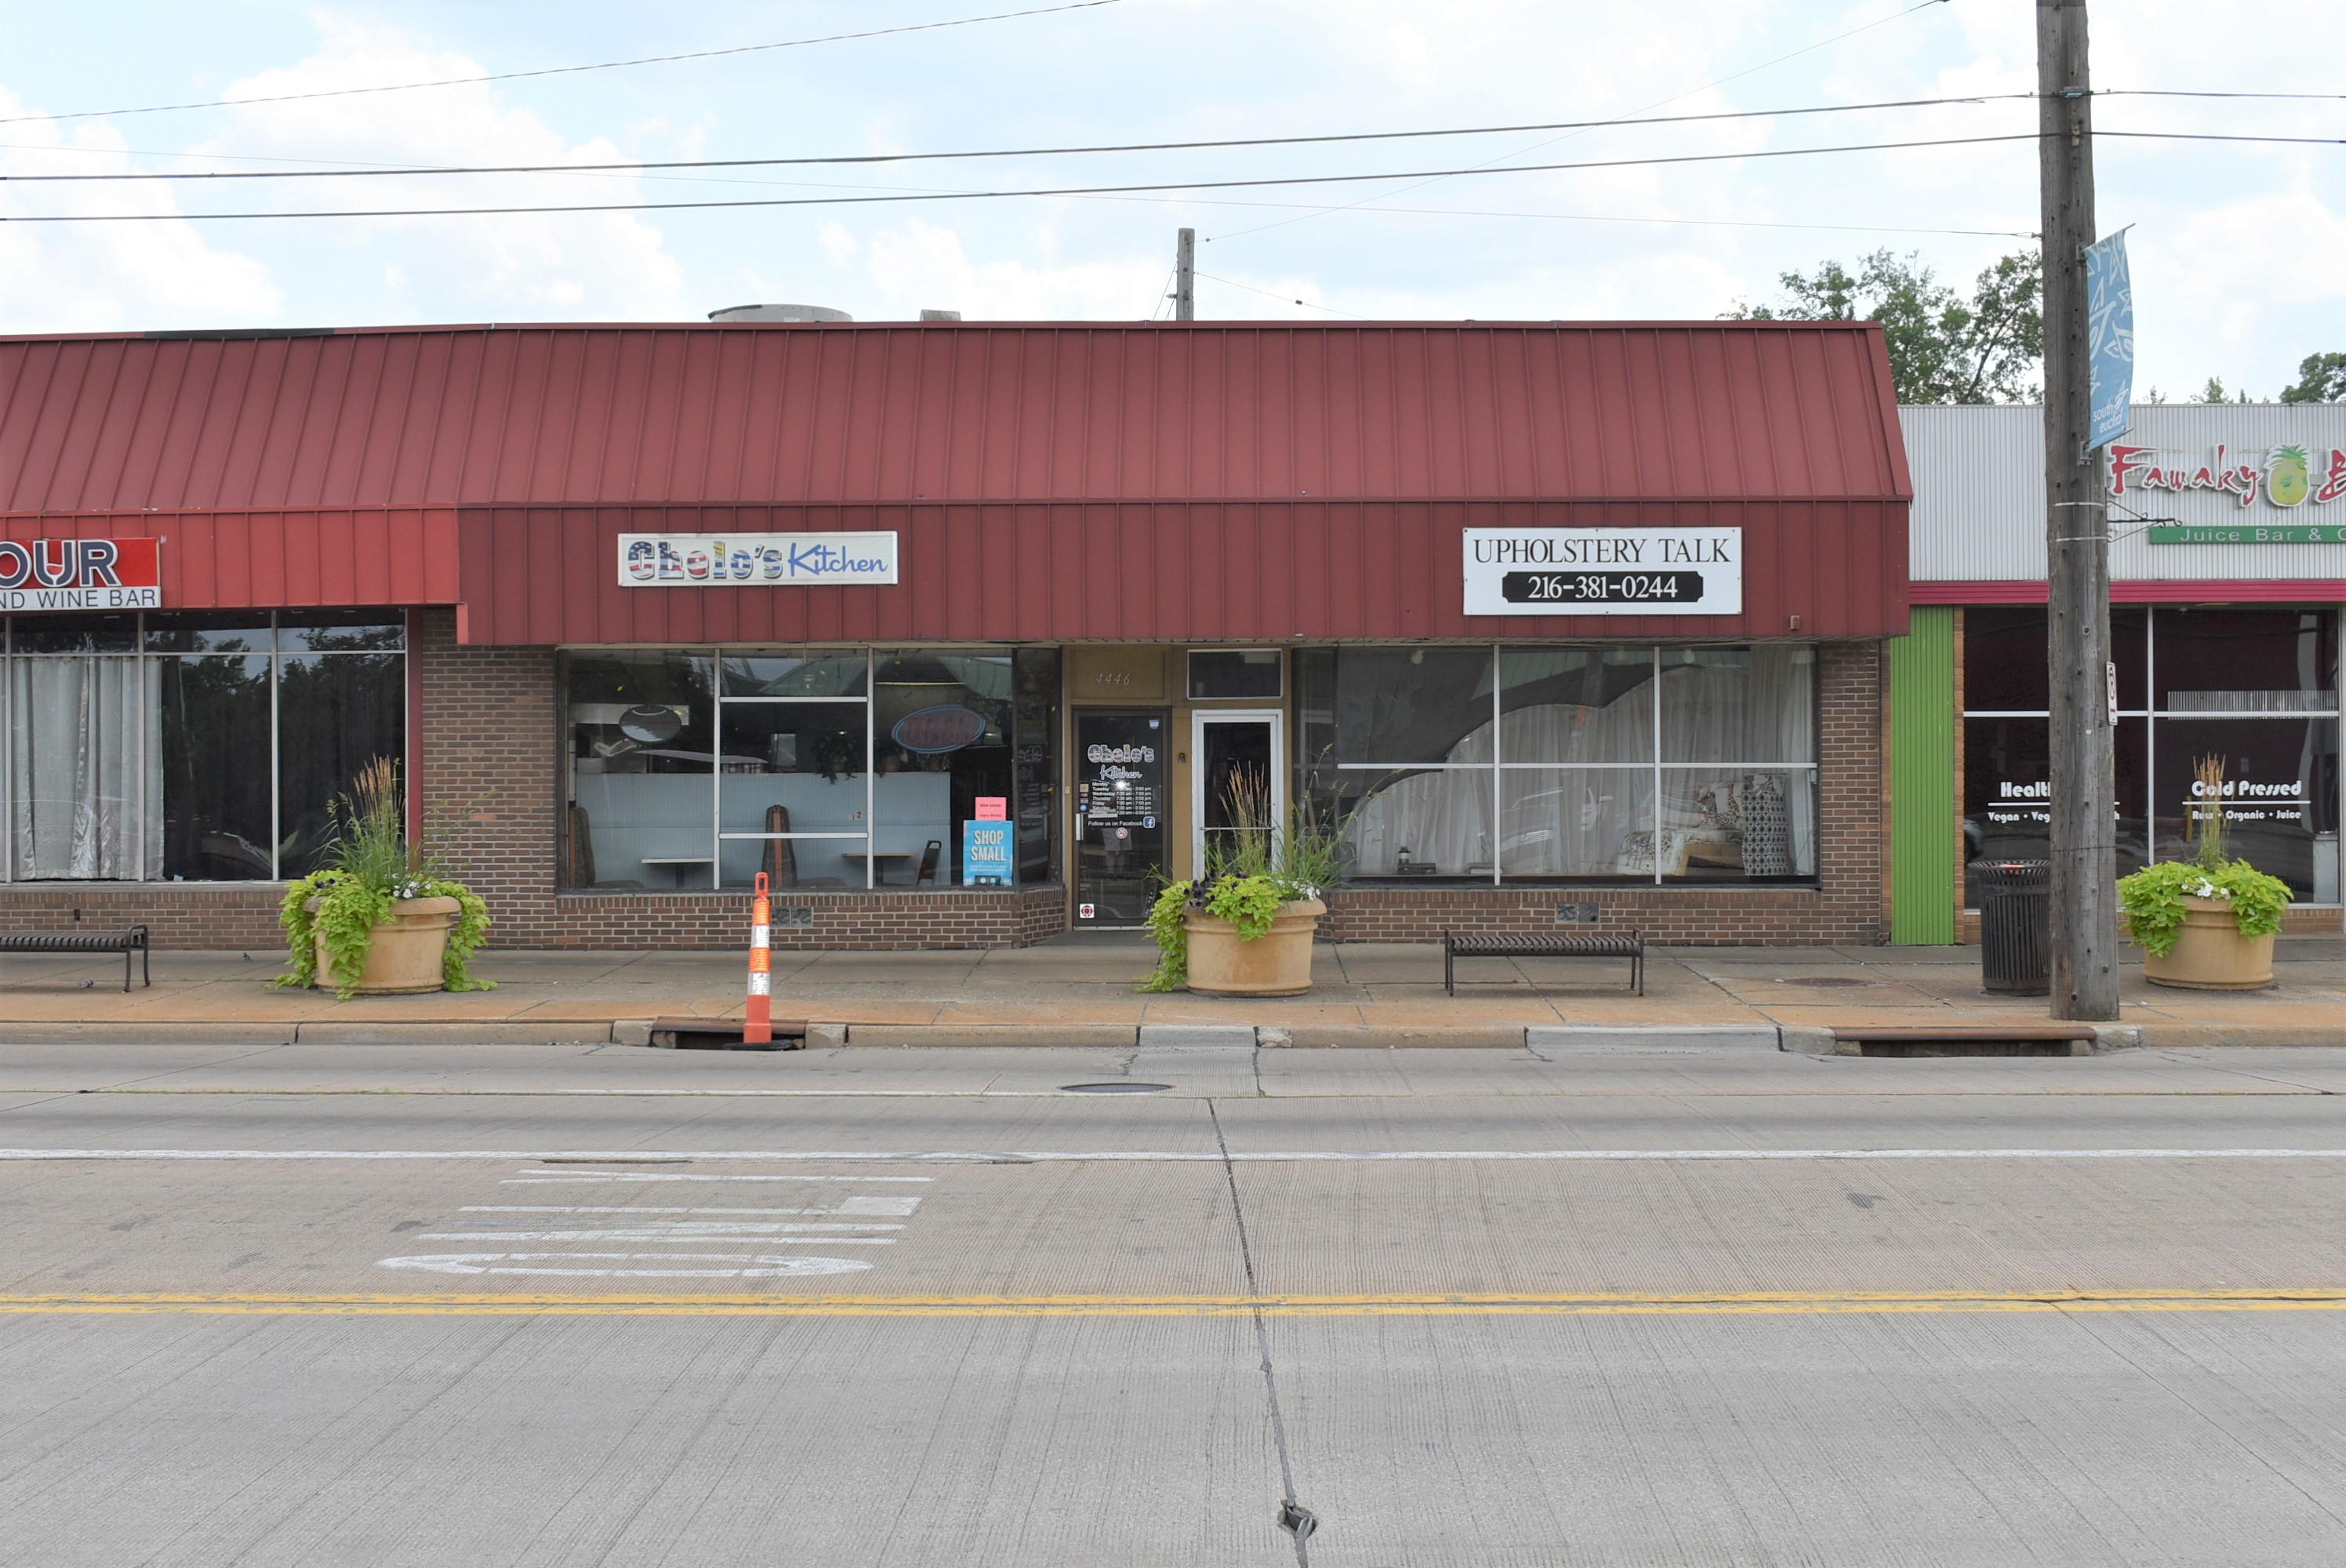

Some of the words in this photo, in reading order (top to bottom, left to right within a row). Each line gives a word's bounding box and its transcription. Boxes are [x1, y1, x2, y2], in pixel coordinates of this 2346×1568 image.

[2093, 398, 2114, 422] south
[2099, 407, 2123, 434] euclid
[2108, 445, 2262, 506] Fawaky
[2181, 528, 2240, 541] Juice
[2255, 528, 2293, 541] Bar
[2308, 528, 2322, 541] &
[628, 541, 783, 579] Chelo's
[788, 542, 888, 576] Kitchen
[1473, 539, 1647, 563] UPHOLSTERY
[1658, 539, 1731, 563] TALK
[1527, 575, 1679, 599] 216-381-0244
[37, 590, 98, 608] WINE
[110, 589, 156, 607] BAR
[1096, 673, 1130, 685] 4446
[903, 715, 977, 746] OPEN
[1088, 744, 1154, 763] Chelo's
[1100, 764, 1142, 780] Kitchen
[2192, 780, 2234, 797] Cold
[2238, 780, 2302, 796] Pressed
[1988, 811, 2020, 823] Vegan
[2225, 810, 2265, 822] Organic
[2276, 810, 2302, 819] Juice
[974, 830, 1004, 845] SHOP
[971, 846, 1006, 862] SMALL
